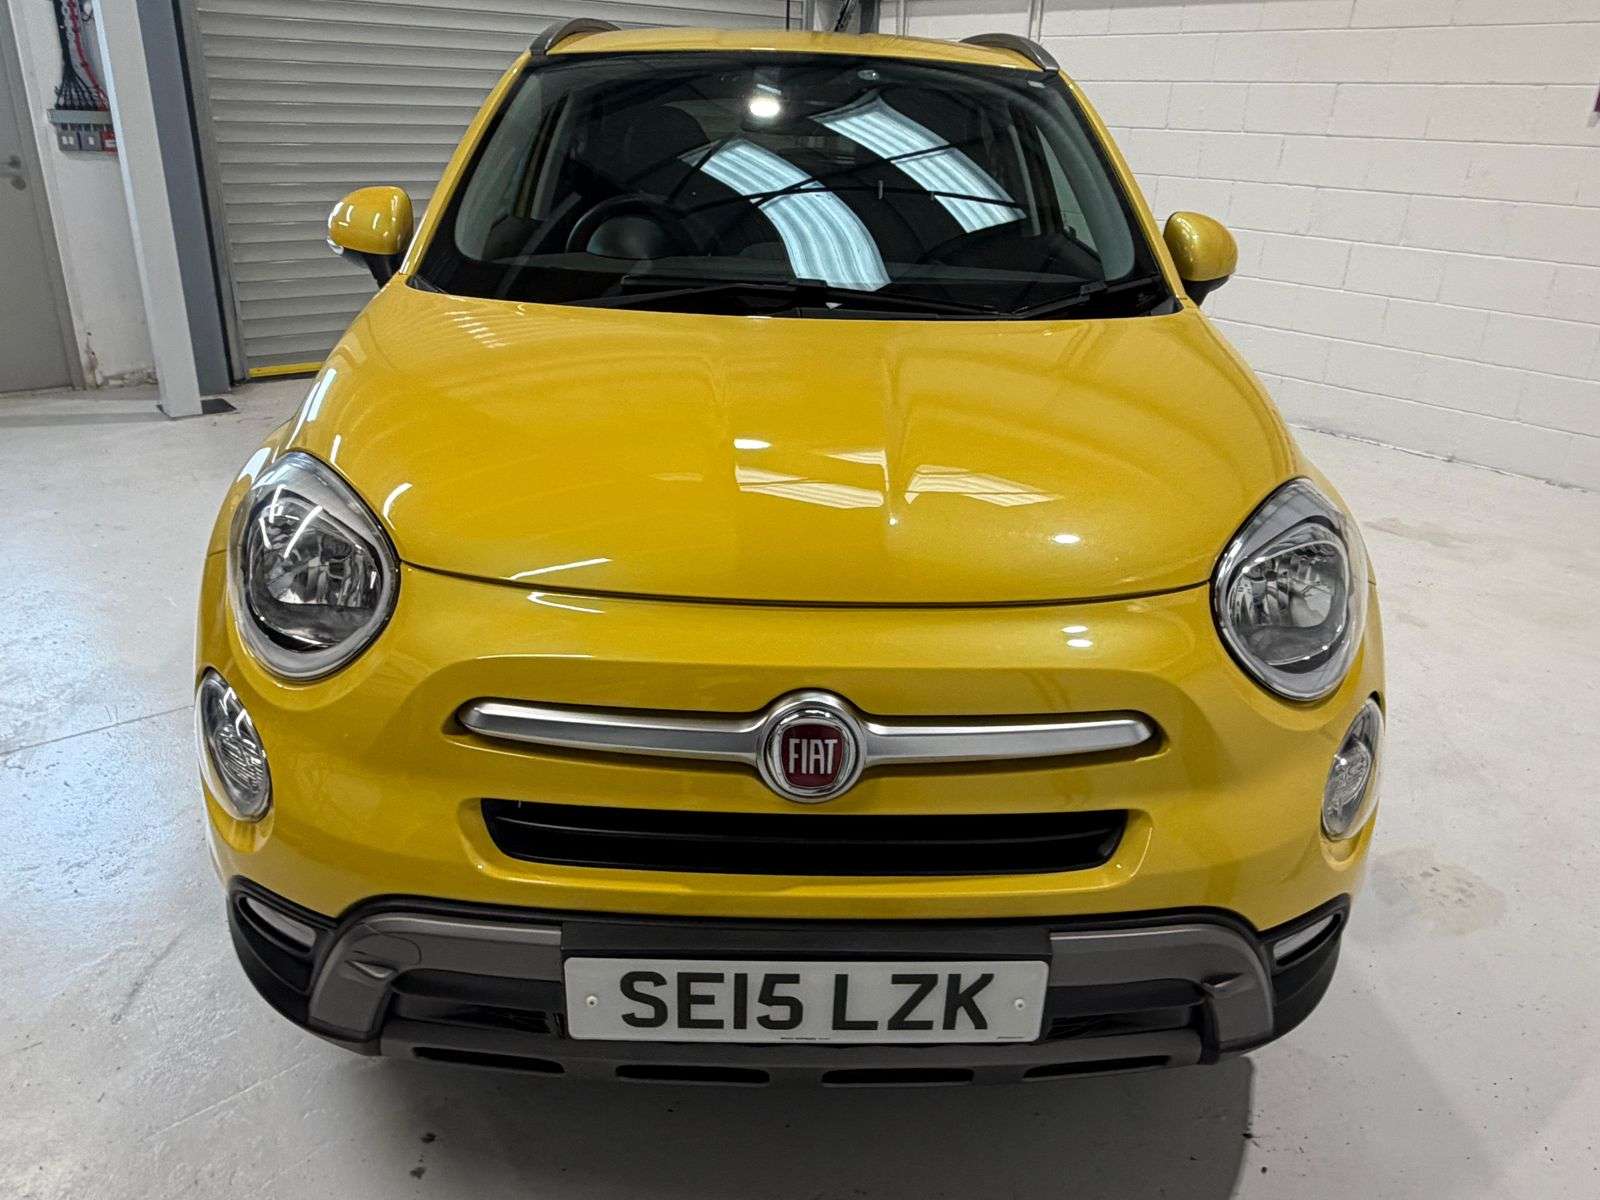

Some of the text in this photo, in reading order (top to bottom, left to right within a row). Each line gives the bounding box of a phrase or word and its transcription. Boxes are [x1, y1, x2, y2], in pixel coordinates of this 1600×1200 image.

[789, 738, 838, 774] FIAT
[620, 971, 995, 1030] SE15 LZK
